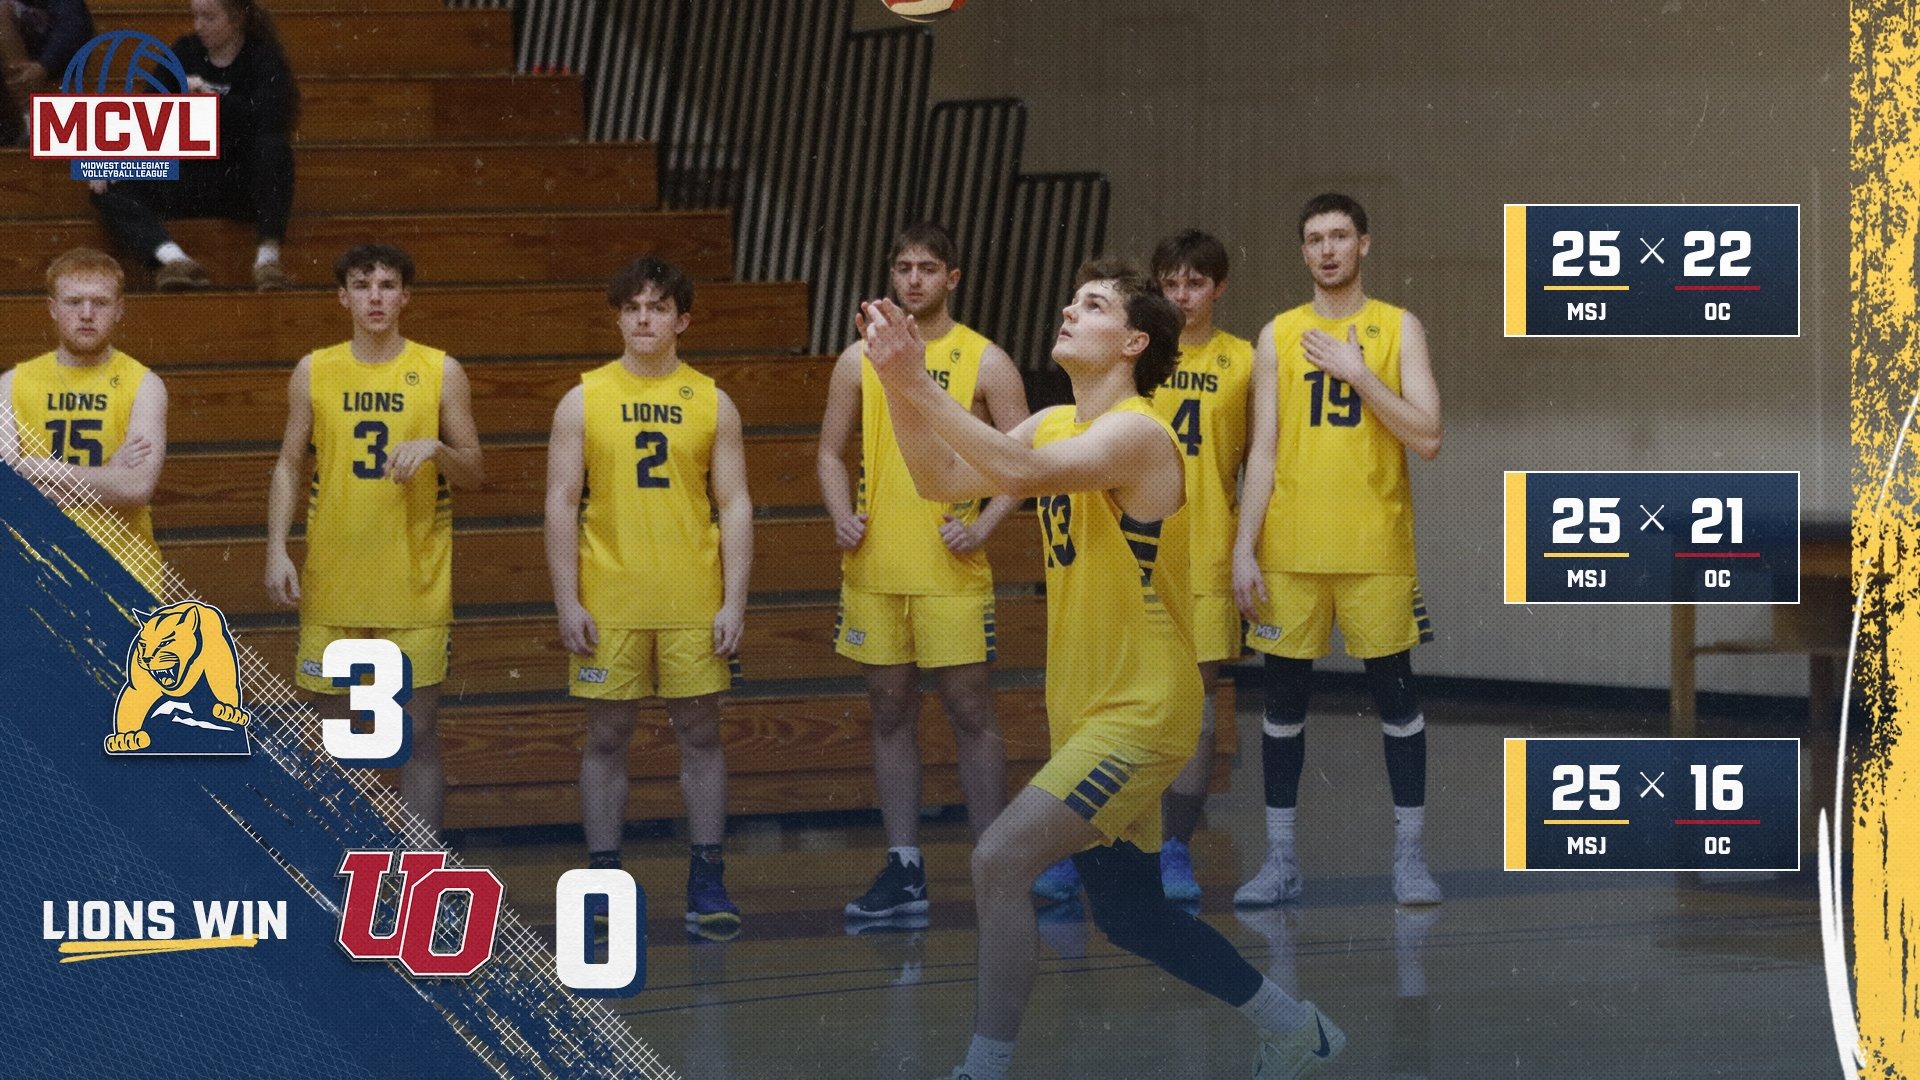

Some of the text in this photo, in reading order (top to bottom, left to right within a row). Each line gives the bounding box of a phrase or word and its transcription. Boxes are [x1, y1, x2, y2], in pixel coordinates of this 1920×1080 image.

[47, 392, 108, 412] LIONS
[343, 391, 405, 413] LIONS
[621, 403, 684, 425] LIONS
[1303, 370, 1362, 428] 19
[45, 419, 103, 467] 15
[352, 420, 389, 480] 3
[1170, 398, 1203, 456] 4
[635, 430, 671, 489] 2
[1039, 494, 1077, 568] 13
[301, 659, 324, 678] MS
[577, 665, 609, 684] MSJ
